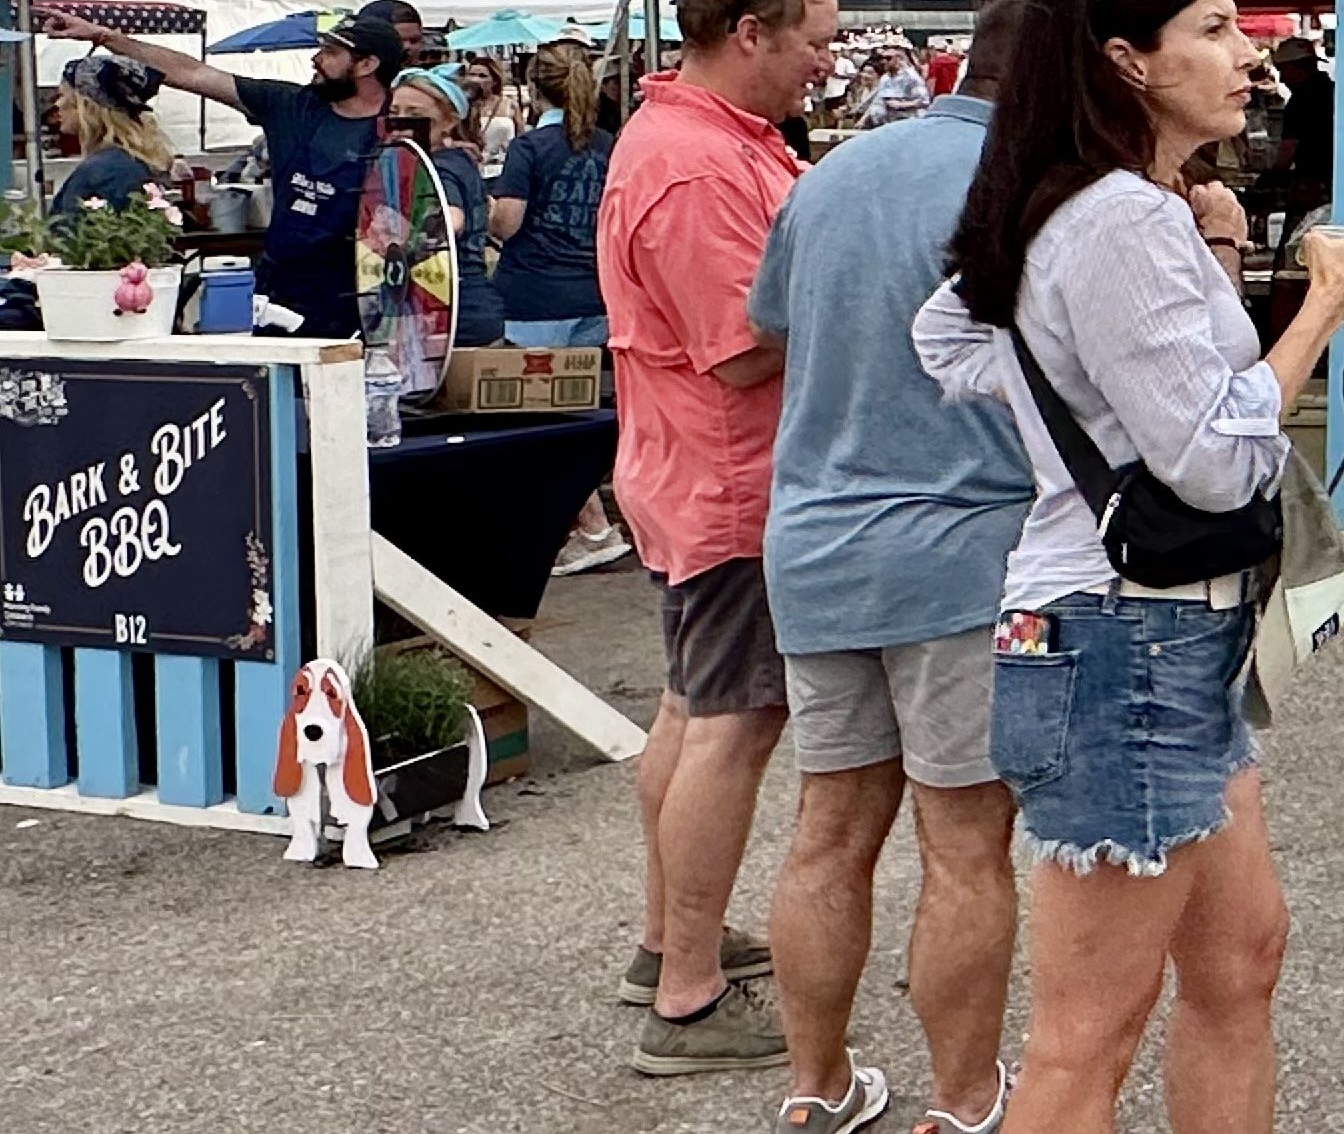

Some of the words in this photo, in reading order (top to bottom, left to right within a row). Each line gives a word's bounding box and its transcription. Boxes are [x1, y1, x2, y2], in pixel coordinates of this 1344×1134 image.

[23, 463, 108, 558] BARK
[118, 453, 141, 496] &
[151, 397, 227, 496] BITE
[80, 498, 182, 587] BBQ
[114, 613, 148, 644] B12
